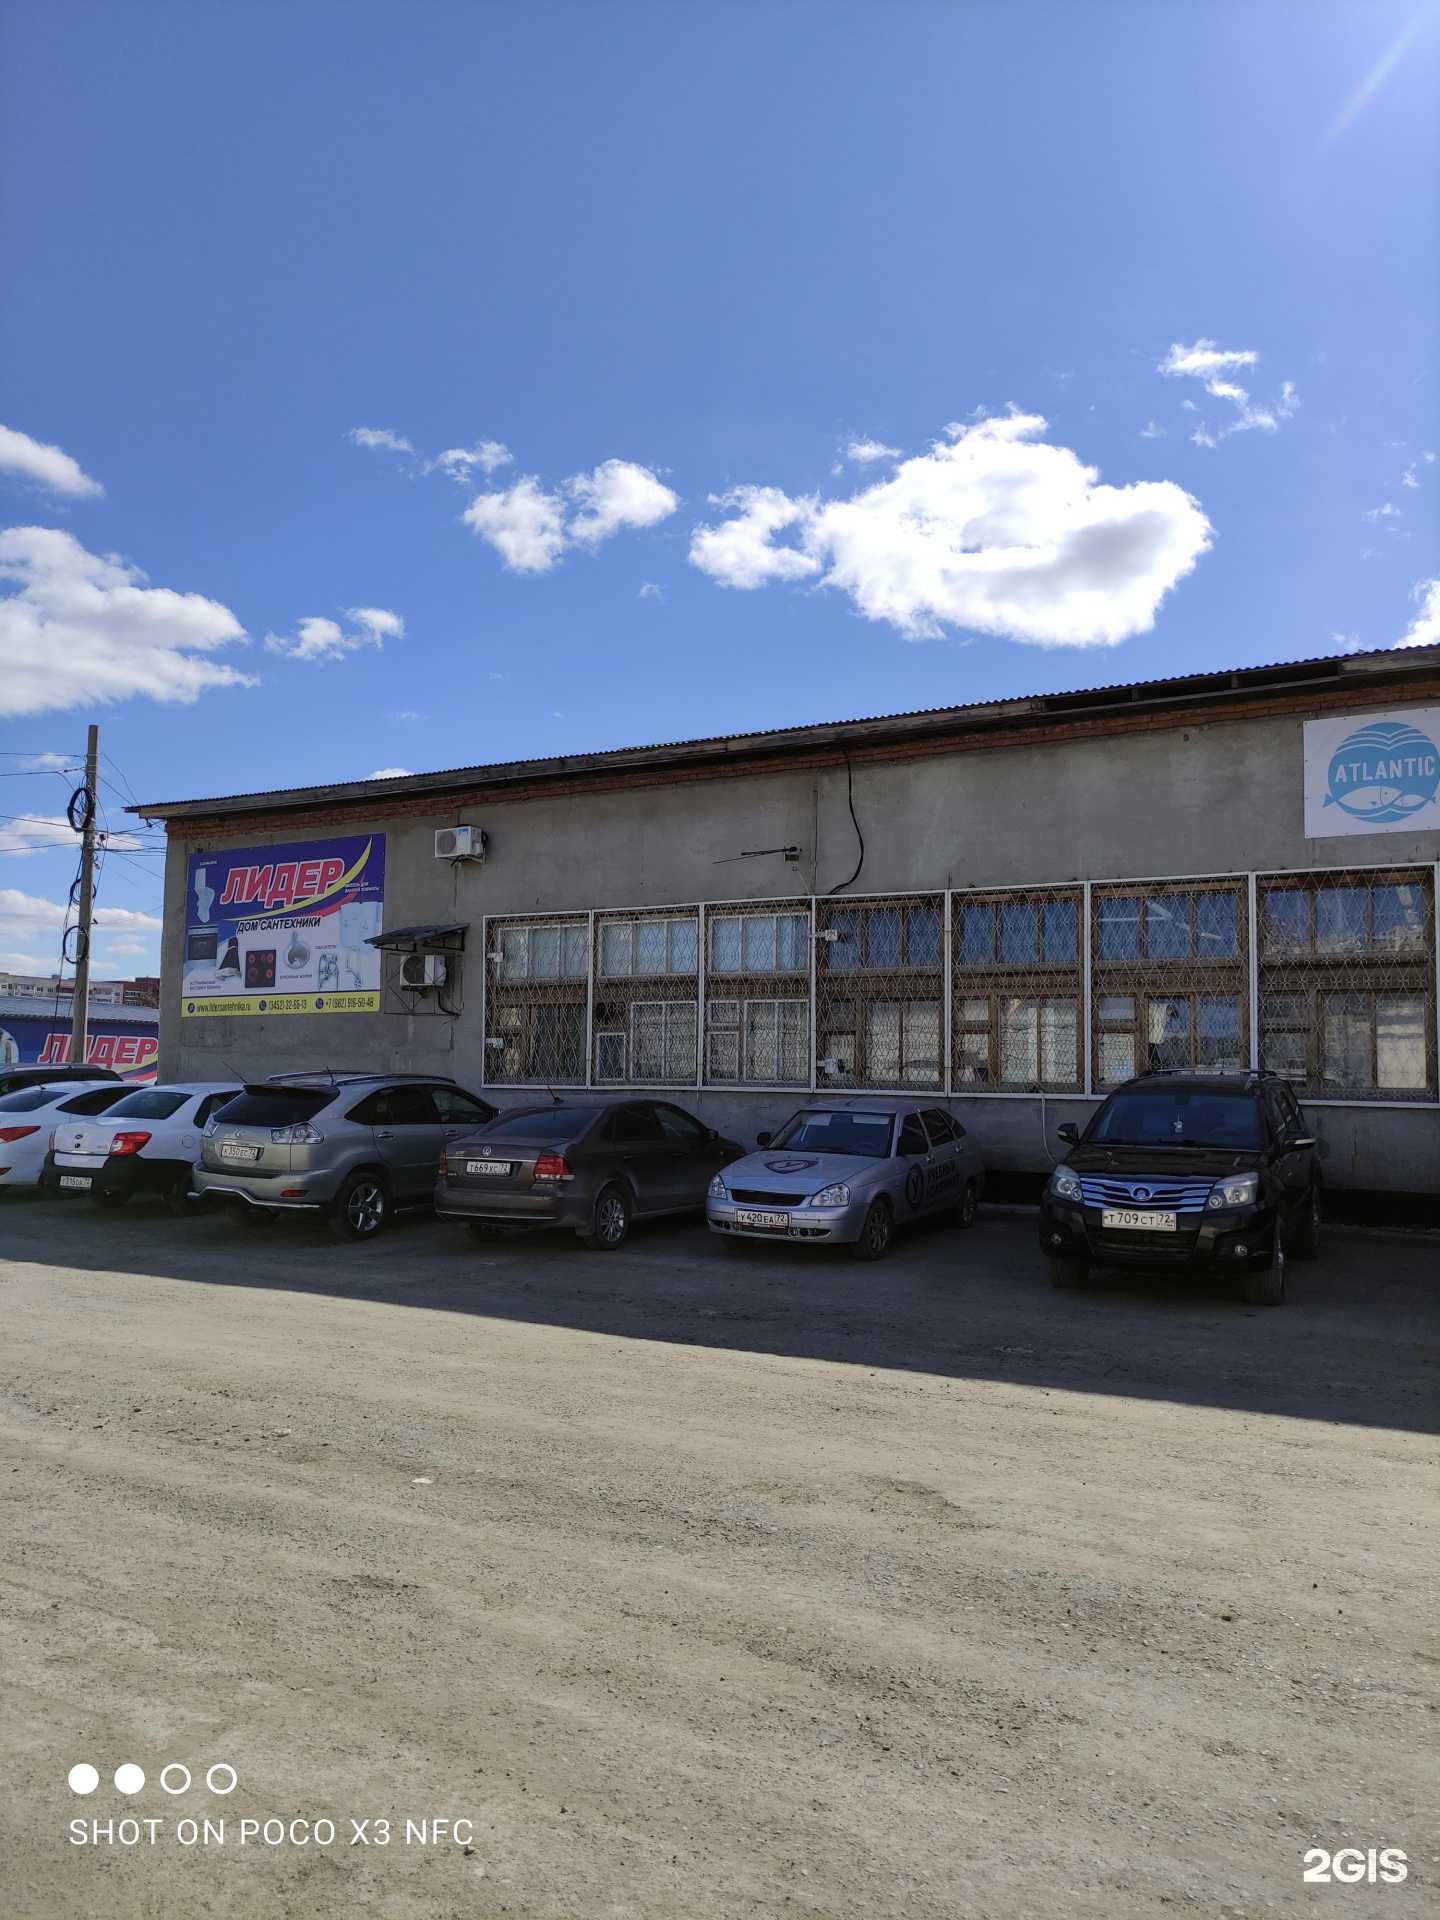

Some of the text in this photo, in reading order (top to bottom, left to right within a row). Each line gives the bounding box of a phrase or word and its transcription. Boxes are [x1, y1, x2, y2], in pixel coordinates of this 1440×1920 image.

[1335, 755, 1435, 783] ATLANTIC
[220, 857, 345, 909] ЛИДЕР
[237, 917, 321, 935] ДОМ САНТЕХНИКИ
